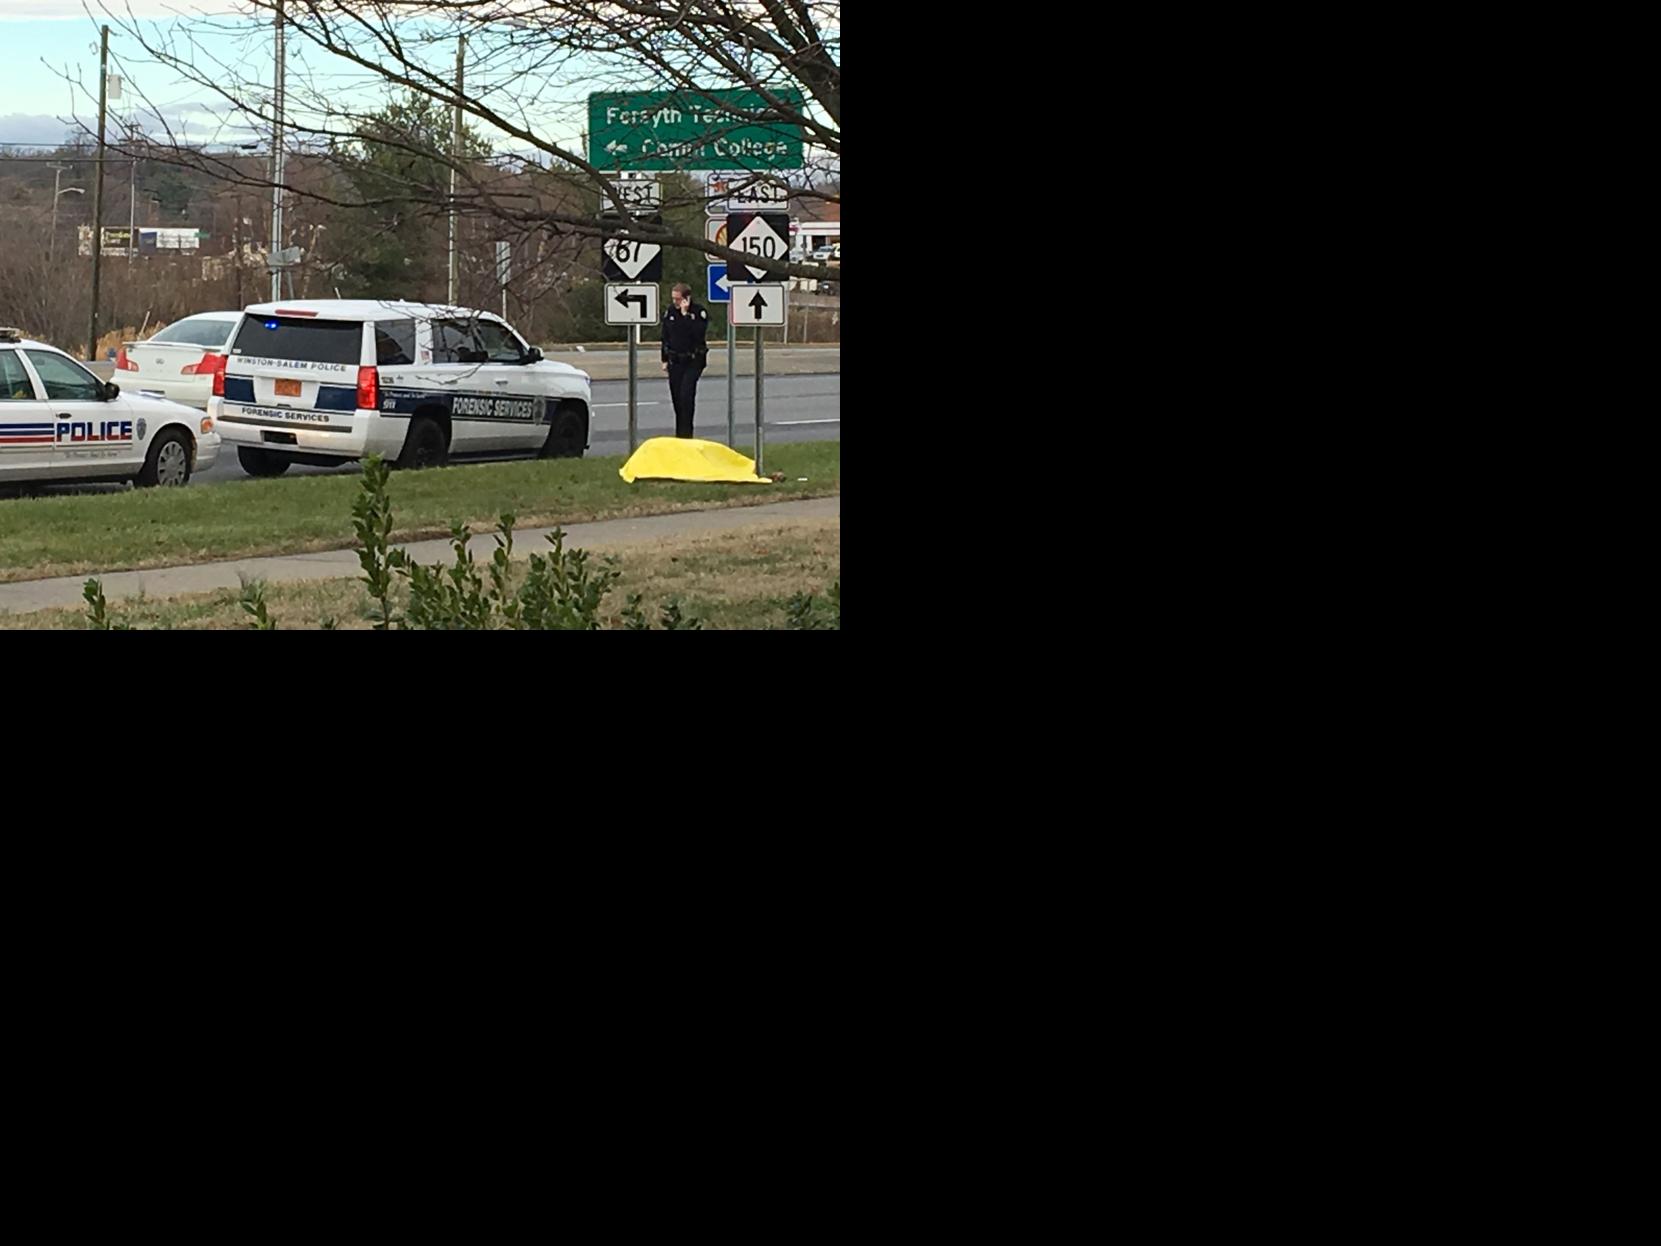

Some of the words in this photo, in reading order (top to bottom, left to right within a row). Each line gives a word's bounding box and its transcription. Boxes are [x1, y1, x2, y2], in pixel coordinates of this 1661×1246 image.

[606, 106, 682, 128] Forsyth
[713, 137, 788, 161] College
[611, 186, 653, 203] EST
[615, 236, 644, 263] 67
[741, 236, 776, 260] 150
[310, 362, 346, 372] POLICE
[242, 407, 283, 419] FORENSIC
[285, 411, 330, 423] SERVICES
[452, 397, 493, 416] FORENSIC
[493, 399, 533, 418] SERVICES
[56, 420, 132, 442] POLICE
